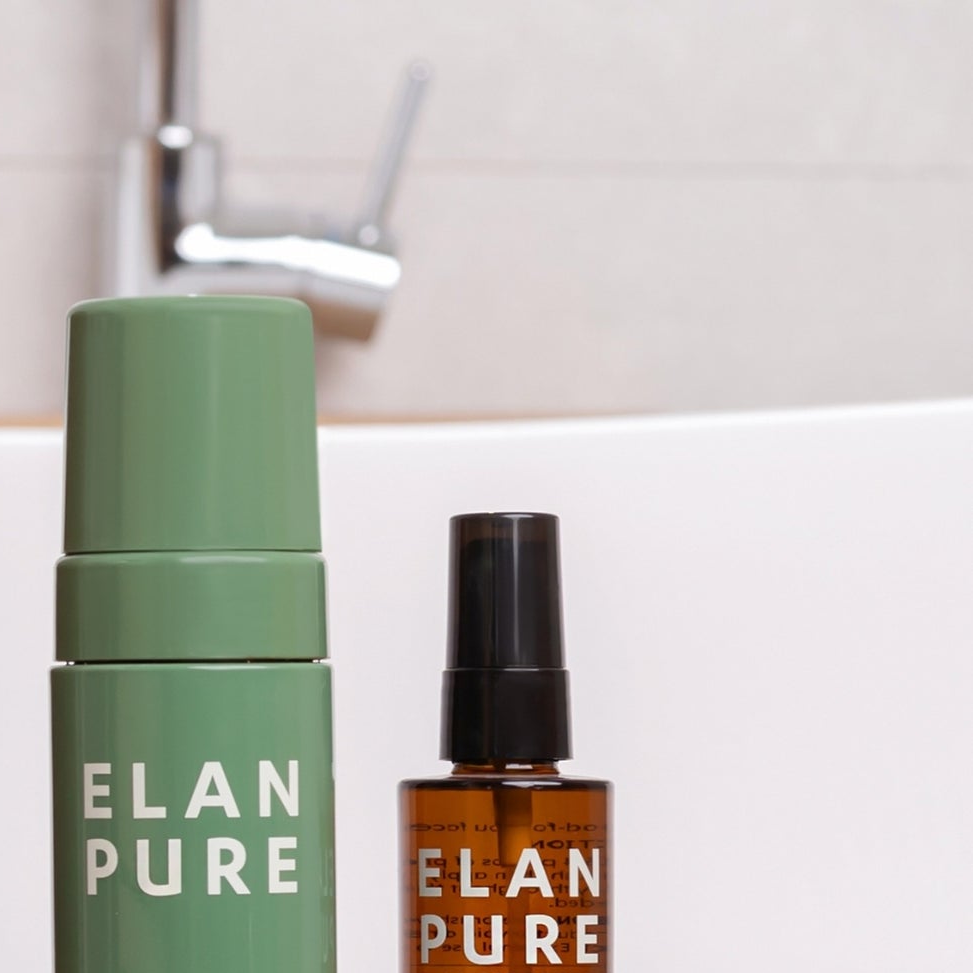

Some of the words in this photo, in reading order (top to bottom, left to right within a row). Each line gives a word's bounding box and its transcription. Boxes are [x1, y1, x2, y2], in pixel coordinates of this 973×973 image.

[83, 760, 299, 819] ELAN
[86, 837, 299, 896] PURE
[418, 848, 600, 897] ELAN
[421, 914, 599, 965] PURE
